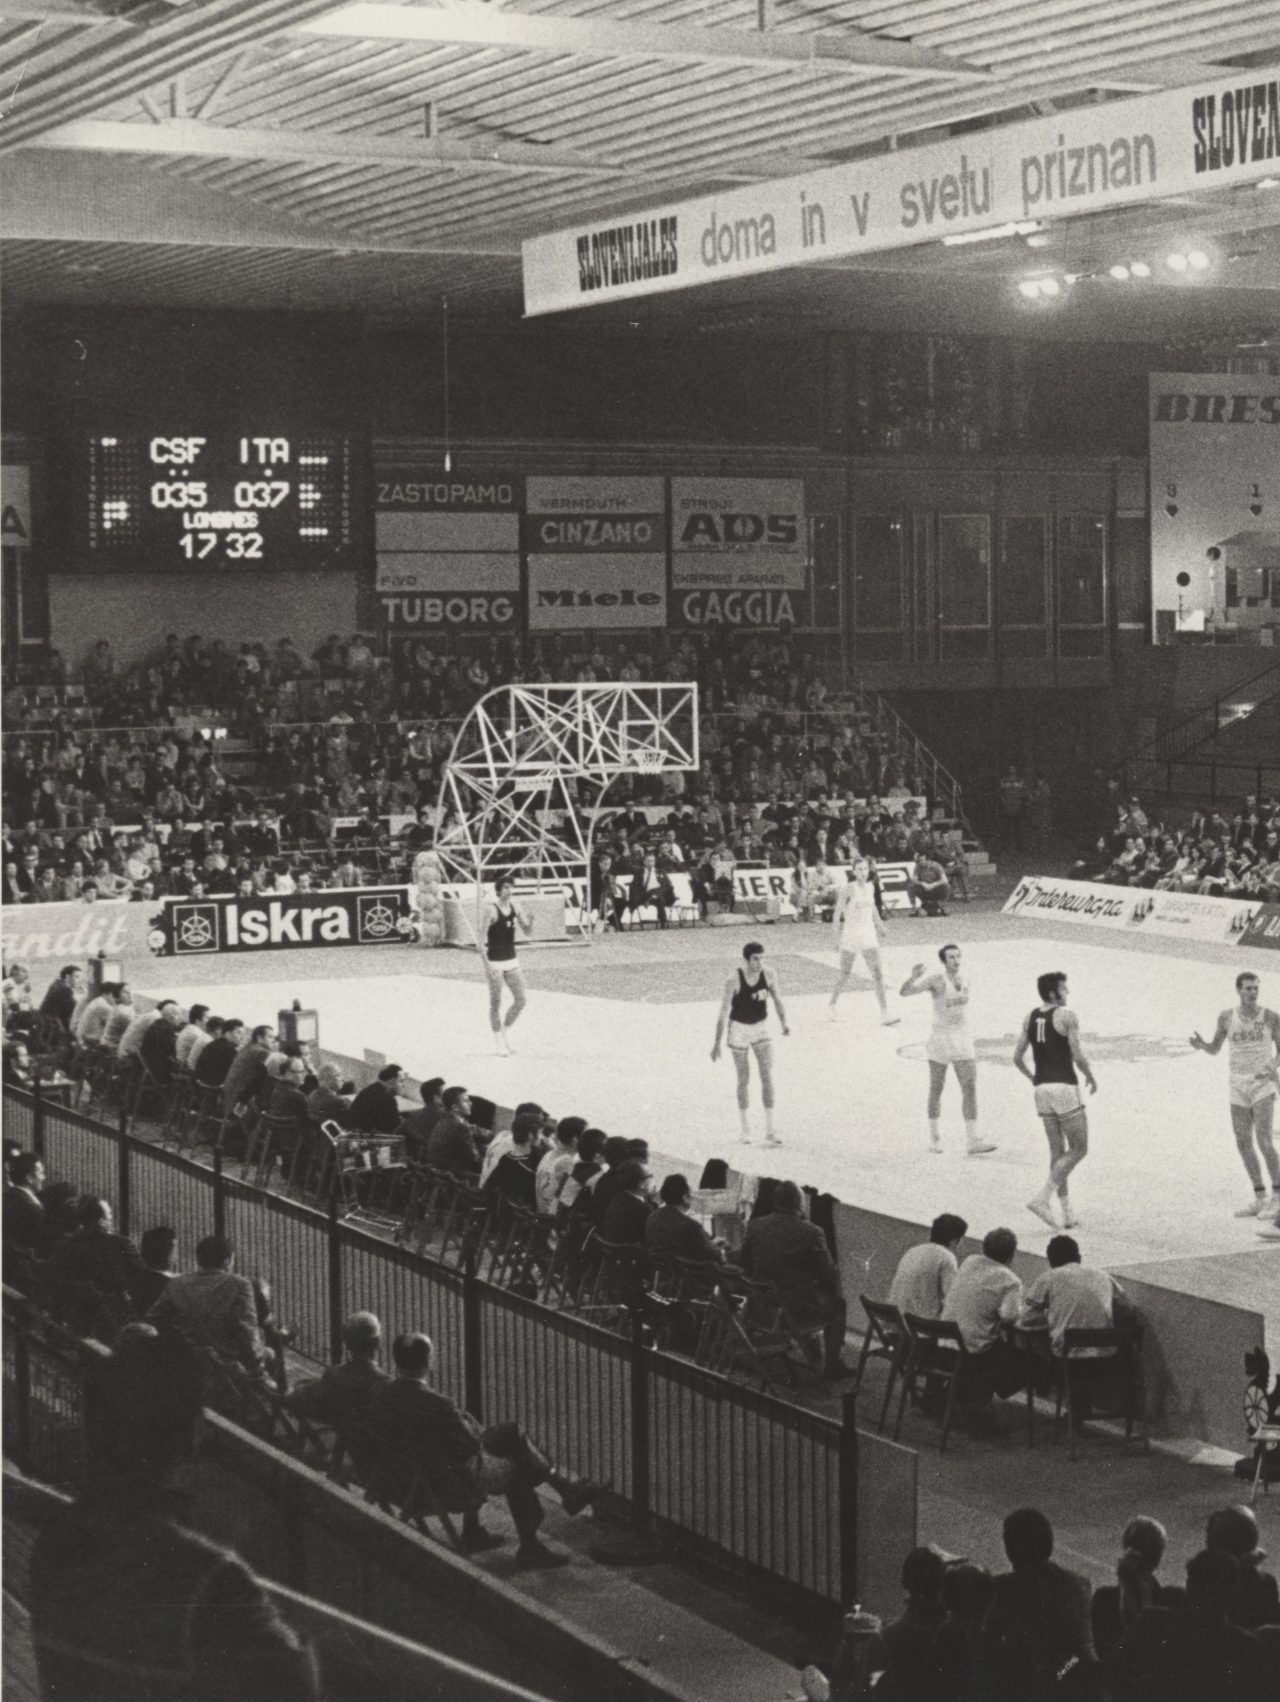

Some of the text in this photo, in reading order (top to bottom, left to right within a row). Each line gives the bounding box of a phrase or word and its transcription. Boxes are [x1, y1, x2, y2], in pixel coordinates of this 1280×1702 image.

[577, 217, 678, 290] SLOVENIJALES
[700, 205, 776, 267] doma
[800, 192, 826, 248] in
[851, 194, 870, 236] v
[900, 156, 991, 228] svetu
[1021, 132, 1157, 206] priznan
[150, 438, 289, 463] CSF ITA
[151, 482, 289, 508] 035 037
[377, 483, 512, 504] ZASTOPAMO
[180, 533, 263, 558] 17 32
[541, 519, 651, 546] CINZANO
[382, 597, 514, 623] TUBORG
[536, 589, 662, 607] Miele
[683, 591, 796, 624] GAGGIA
[226, 902, 351, 945] Iskra
